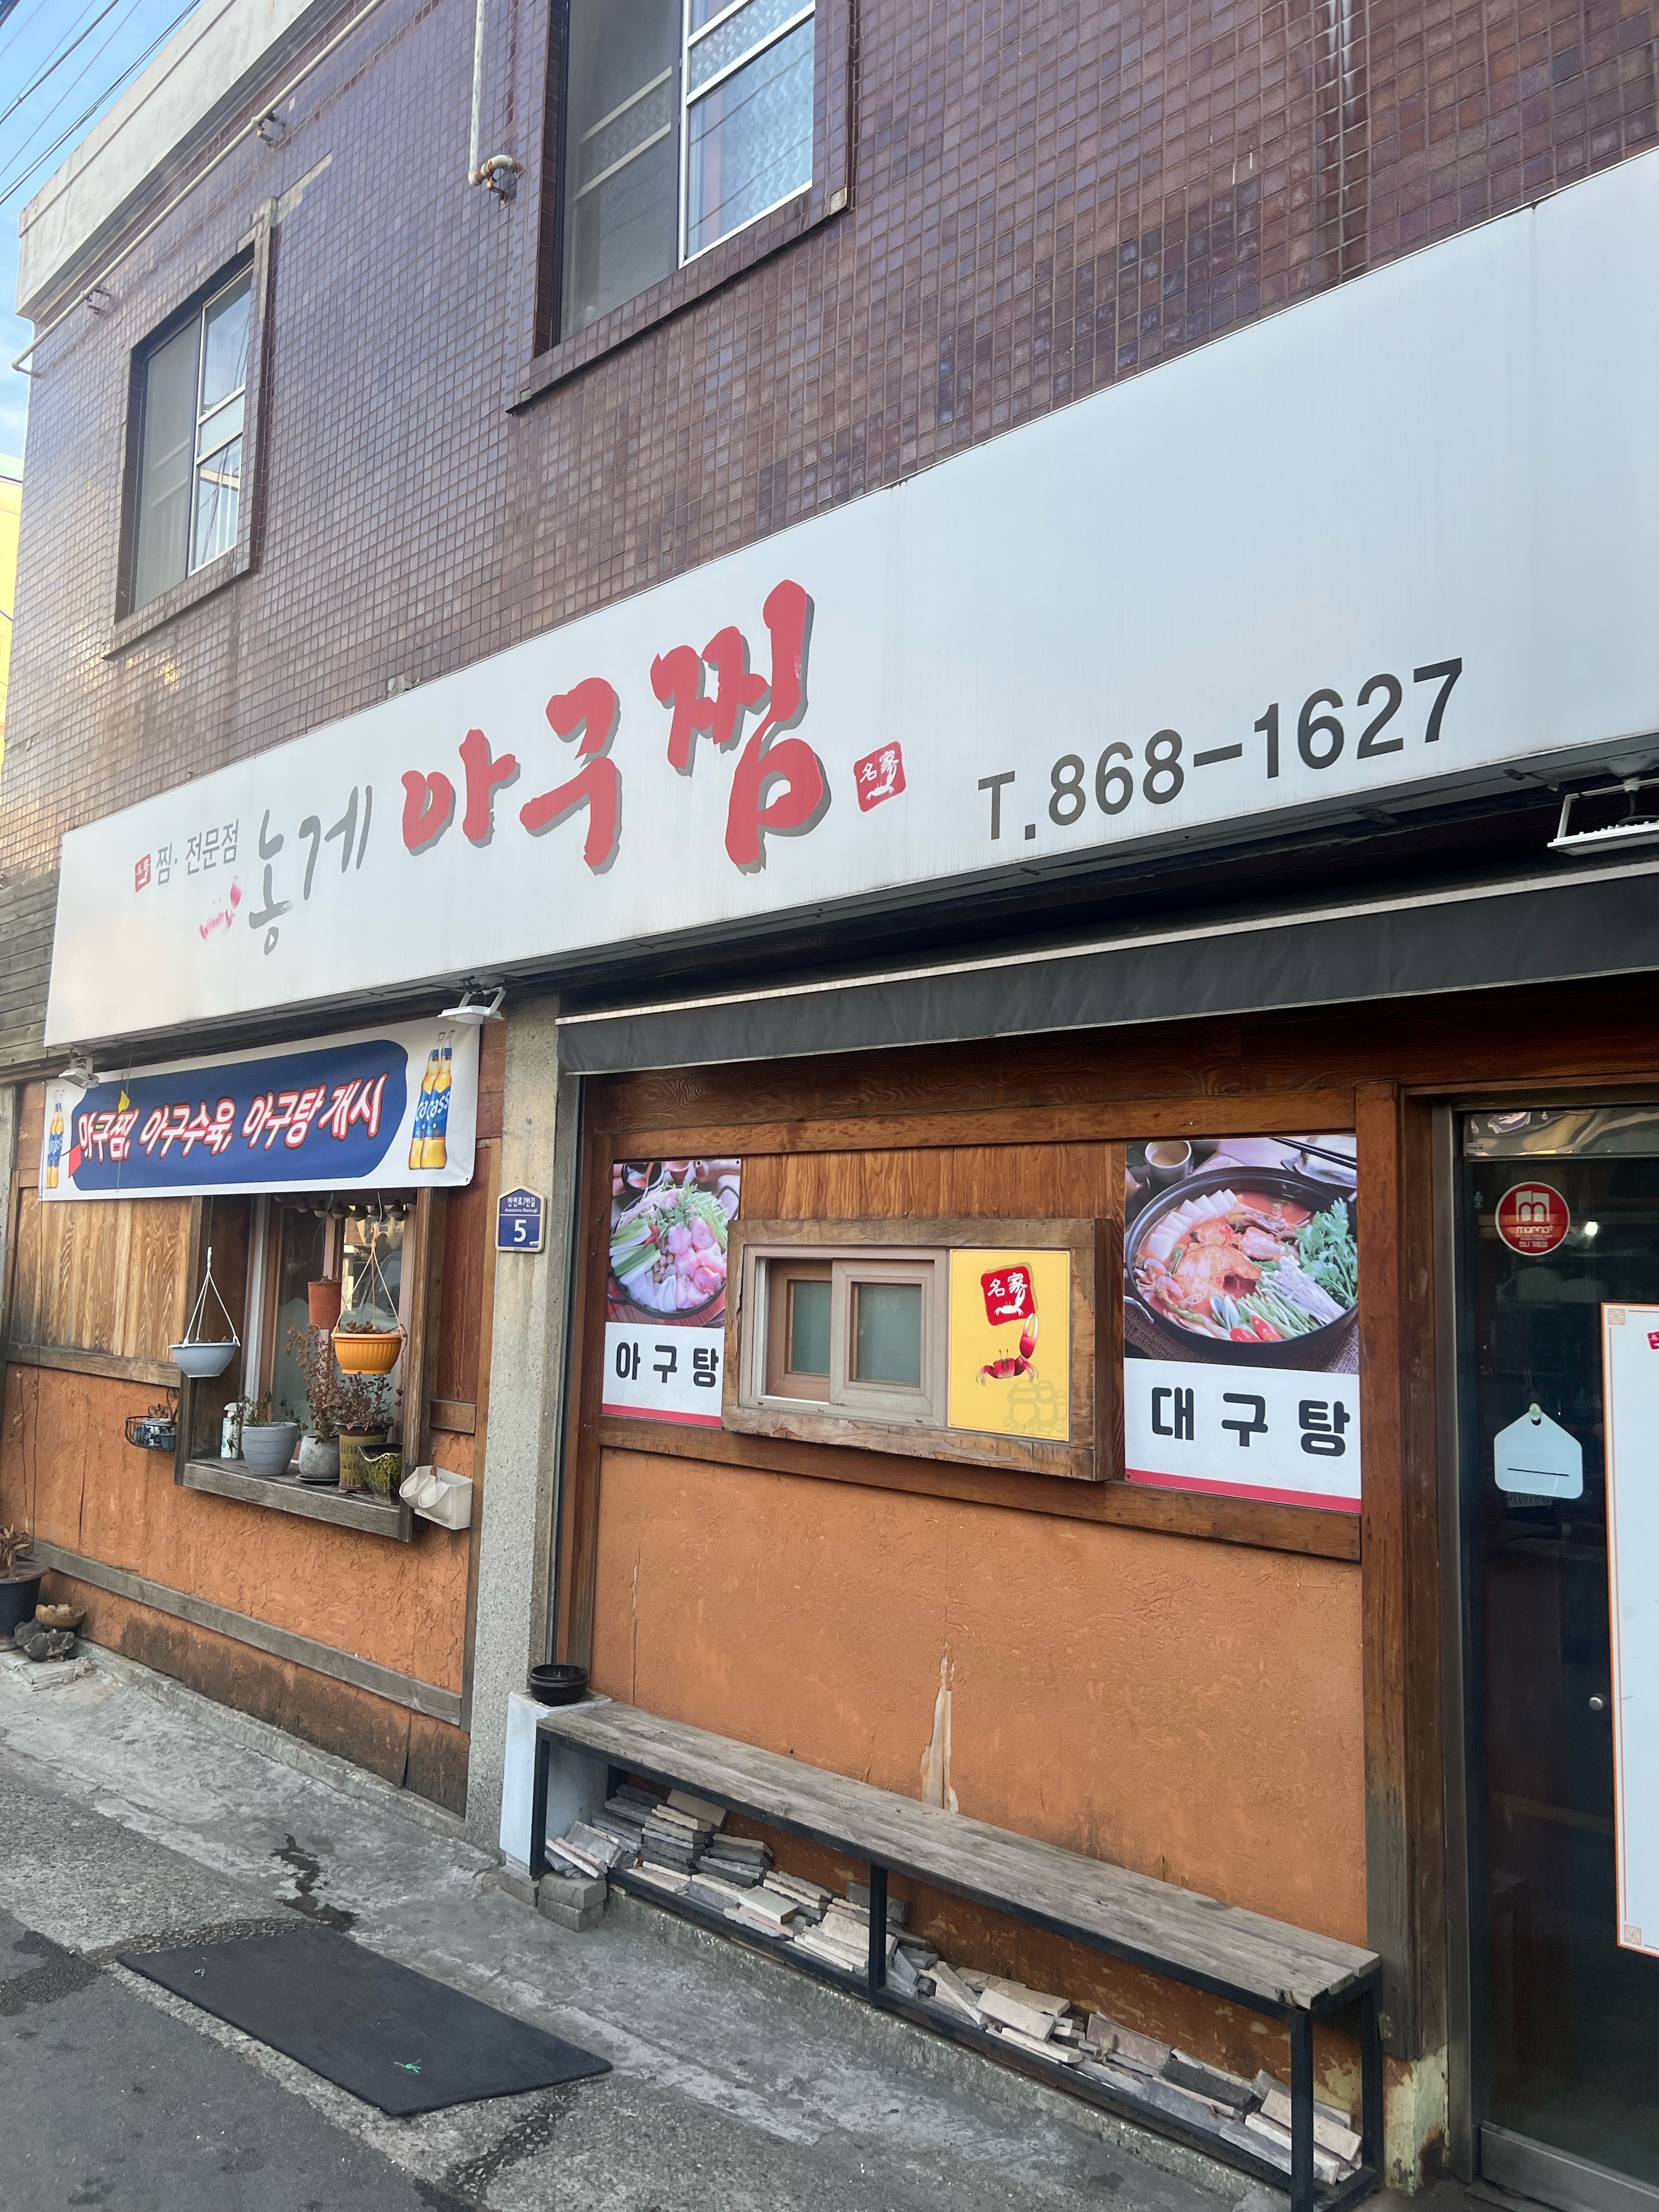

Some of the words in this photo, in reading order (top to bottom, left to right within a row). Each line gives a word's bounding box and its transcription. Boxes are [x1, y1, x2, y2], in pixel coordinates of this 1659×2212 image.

[185, 819, 239, 876] 전문점
[241, 1085, 326, 1149] 아구탕
[318, 1073, 388, 1139] 개시
[514, 1219, 527, 1243] 5
[987, 1272, 1028, 1297] 名家
[616, 1342, 719, 1388] 아구탕
[1152, 1387, 1351, 1457] 대구탕
